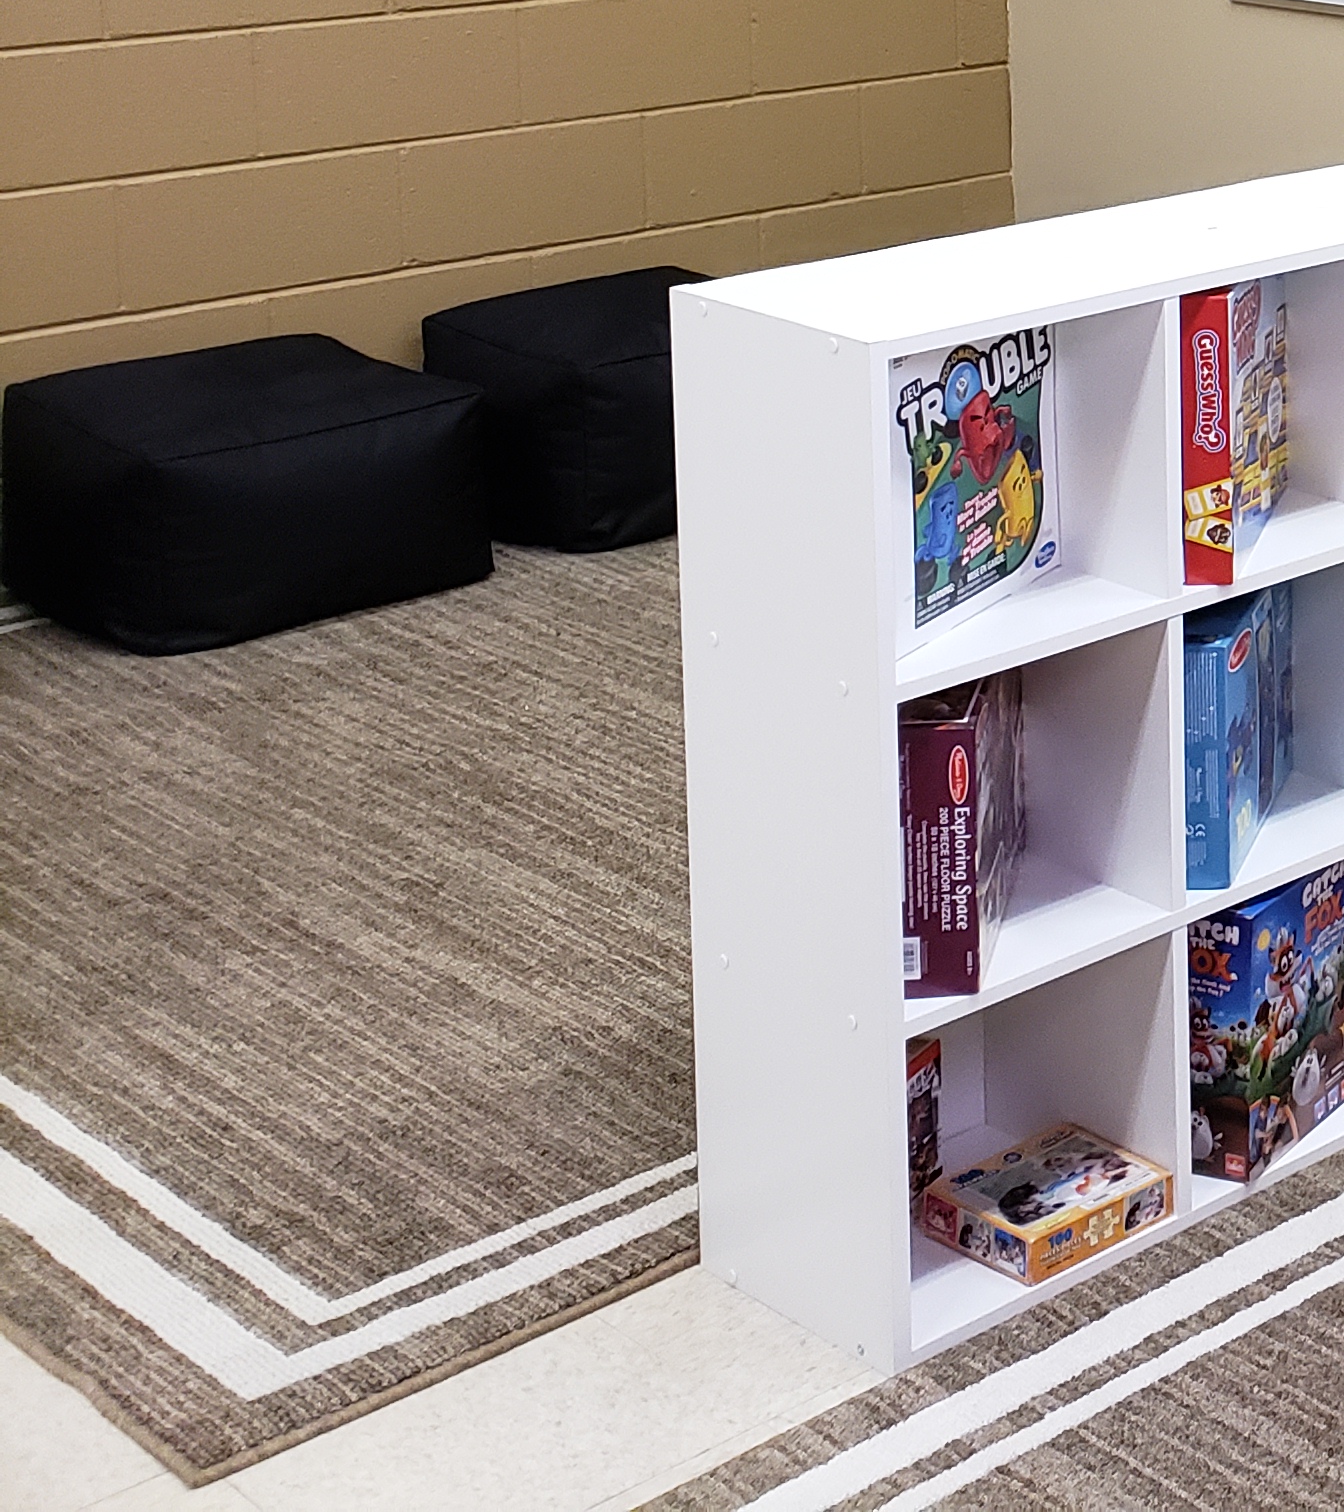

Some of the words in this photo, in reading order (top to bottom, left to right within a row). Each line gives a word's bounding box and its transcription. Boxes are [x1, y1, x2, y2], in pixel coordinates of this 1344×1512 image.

[901, 380, 921, 405] JEU
[1016, 366, 1043, 395] GAME
[939, 807, 949, 824] 200
[940, 826, 950, 857] PIECE
[950, 807, 972, 880] Exploring
[941, 858, 950, 892] FLOOR
[941, 894, 951, 932] PUZZLE
[951, 884, 972, 930] Space
[1191, 948, 1236, 983] OX
